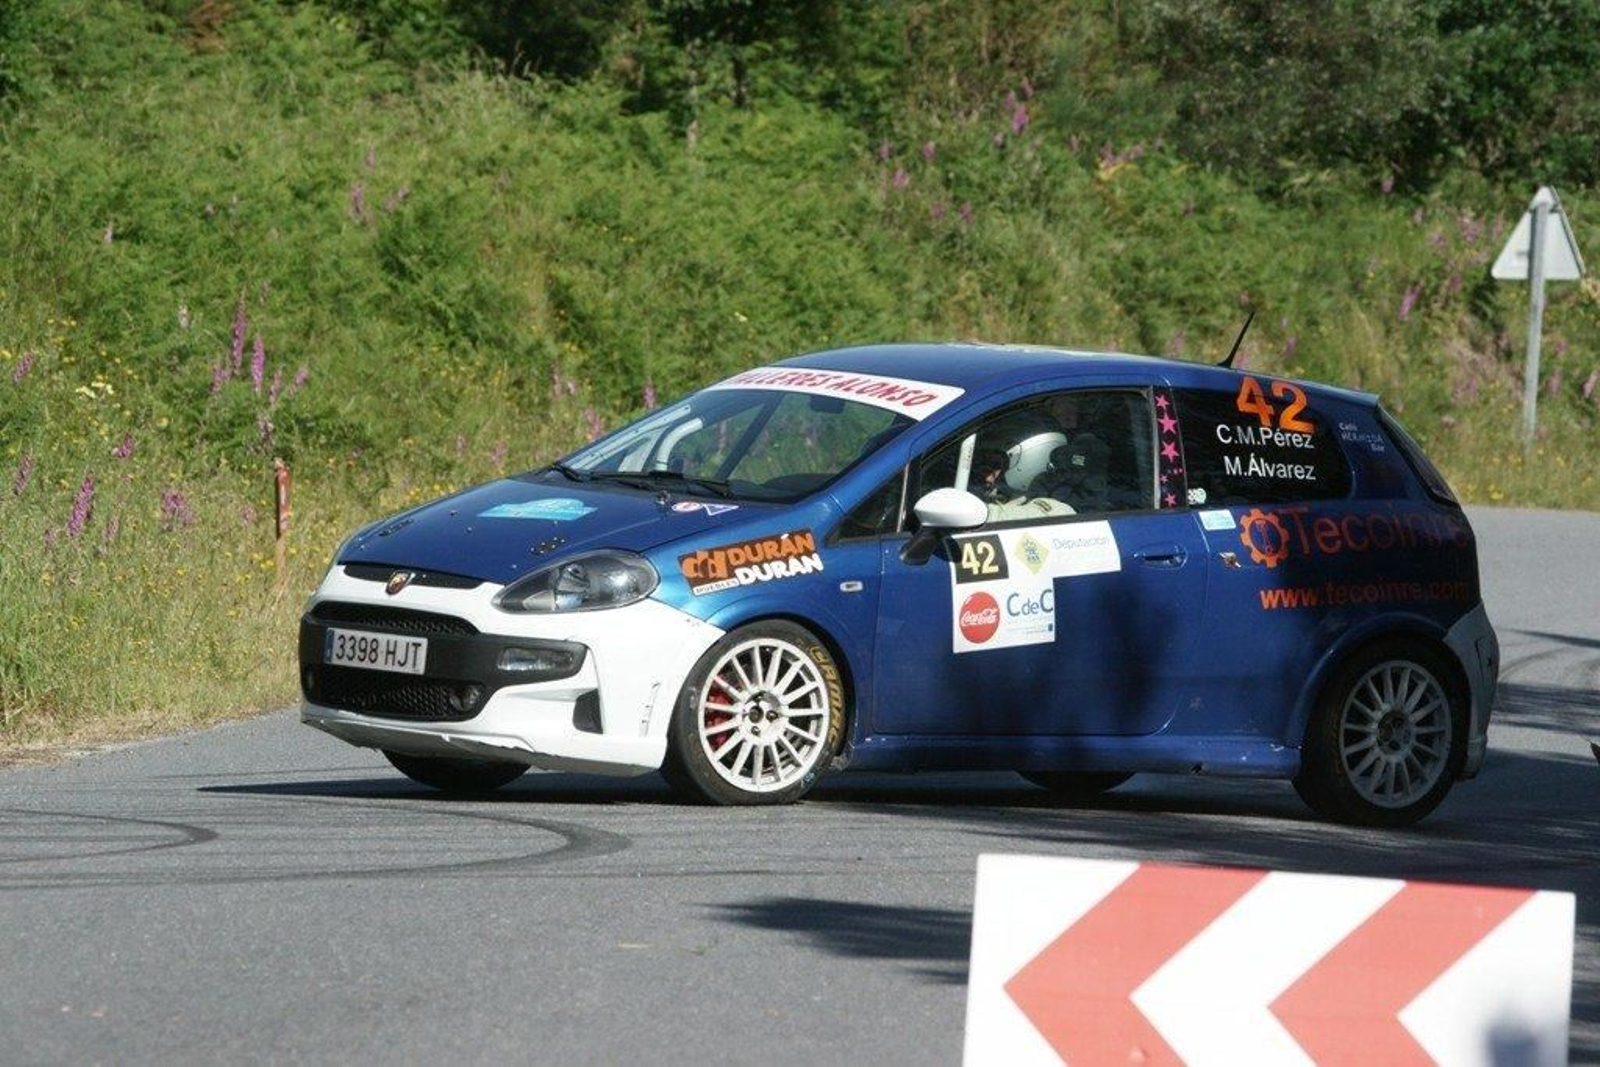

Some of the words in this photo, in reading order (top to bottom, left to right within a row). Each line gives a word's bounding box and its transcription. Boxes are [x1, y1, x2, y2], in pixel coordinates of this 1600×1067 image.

[826, 376, 938, 407] ALONSO
[1236, 375, 1315, 433] 42
[1216, 423, 1315, 449] C.M.Pérez
[1223, 452, 1317, 481] M.Álvarez
[727, 532, 816, 567] DURÁN
[961, 540, 999, 575] 42
[1259, 576, 1471, 611] www.tecoinre.com
[335, 634, 379, 664] 3398
[384, 639, 422, 669] HJT
